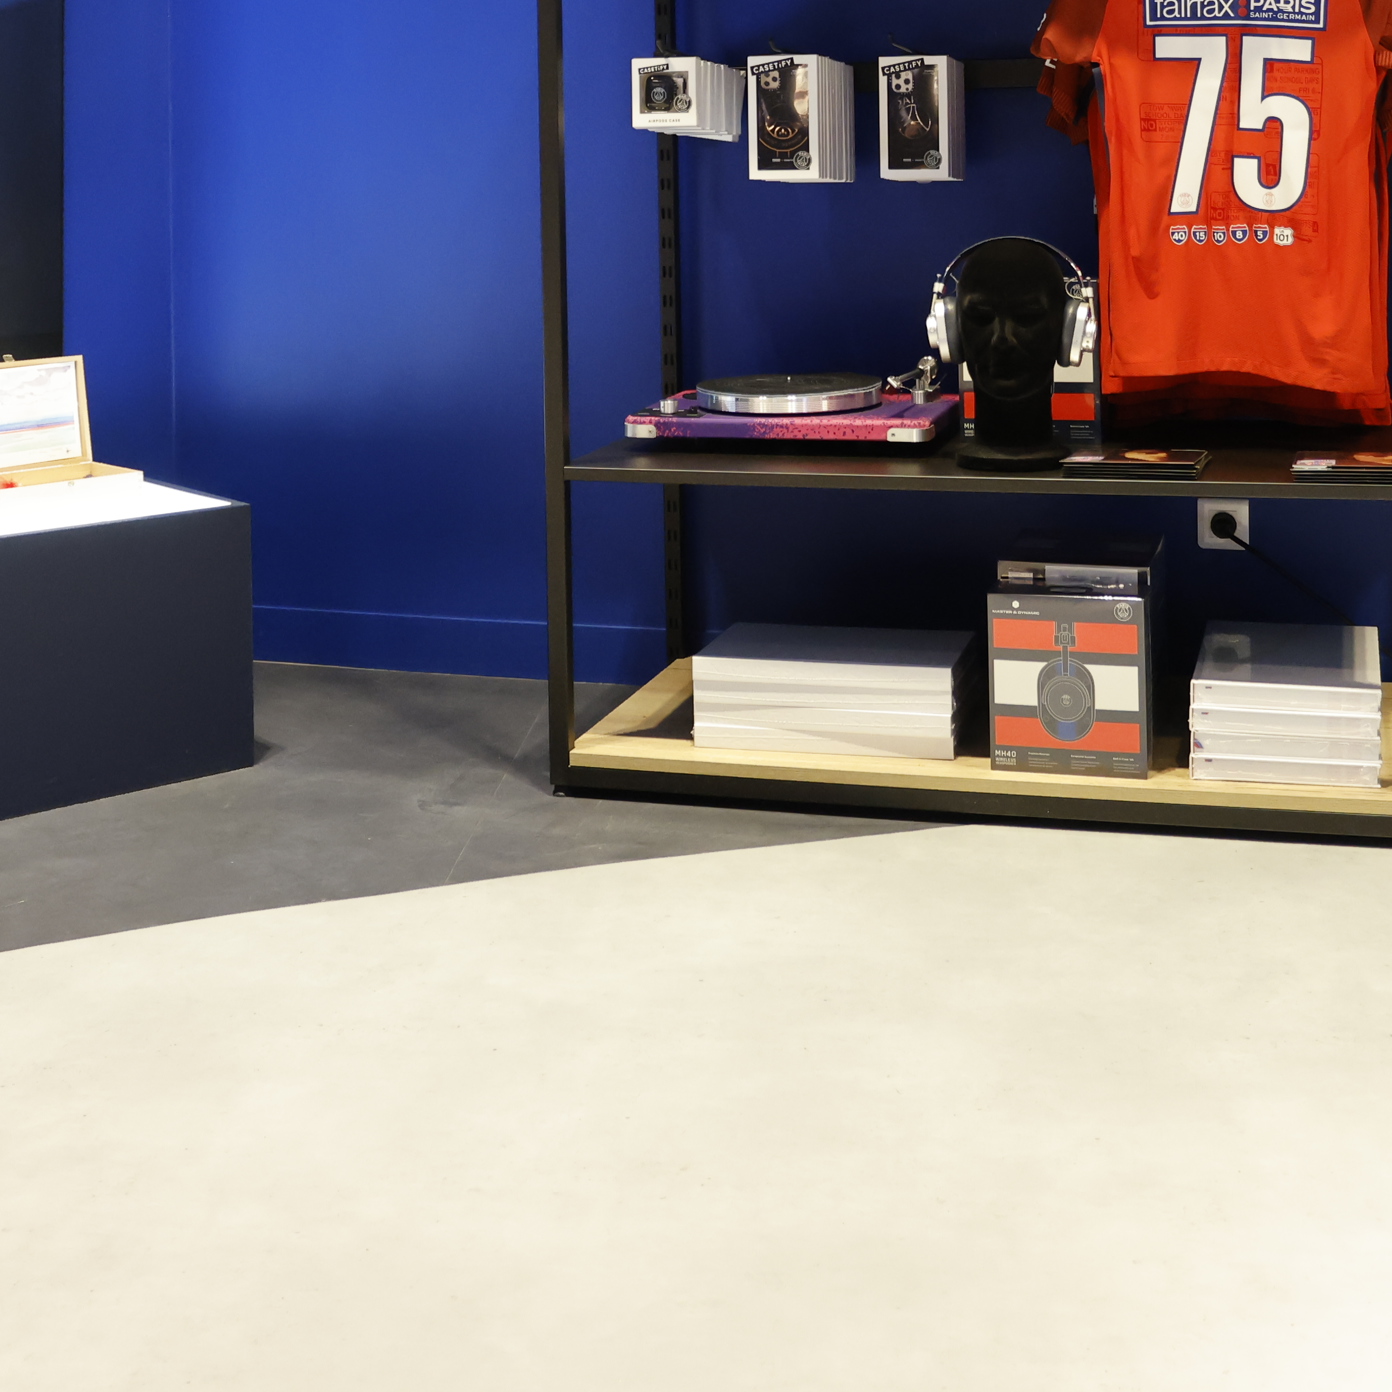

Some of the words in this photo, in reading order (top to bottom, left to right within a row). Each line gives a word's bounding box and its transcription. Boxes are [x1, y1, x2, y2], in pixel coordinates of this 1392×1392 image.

[1141, 120, 1156, 130] NO
[1153, 33, 1315, 216] 75
[1172, 232, 1185, 241] 40
[1195, 231, 1205, 241] 15
[1213, 232, 1224, 241] 10
[1236, 230, 1243, 239] 8
[1257, 230, 1264, 239] 5
[1275, 233, 1289, 242] 101
[994, 749, 1017, 758] MH40
